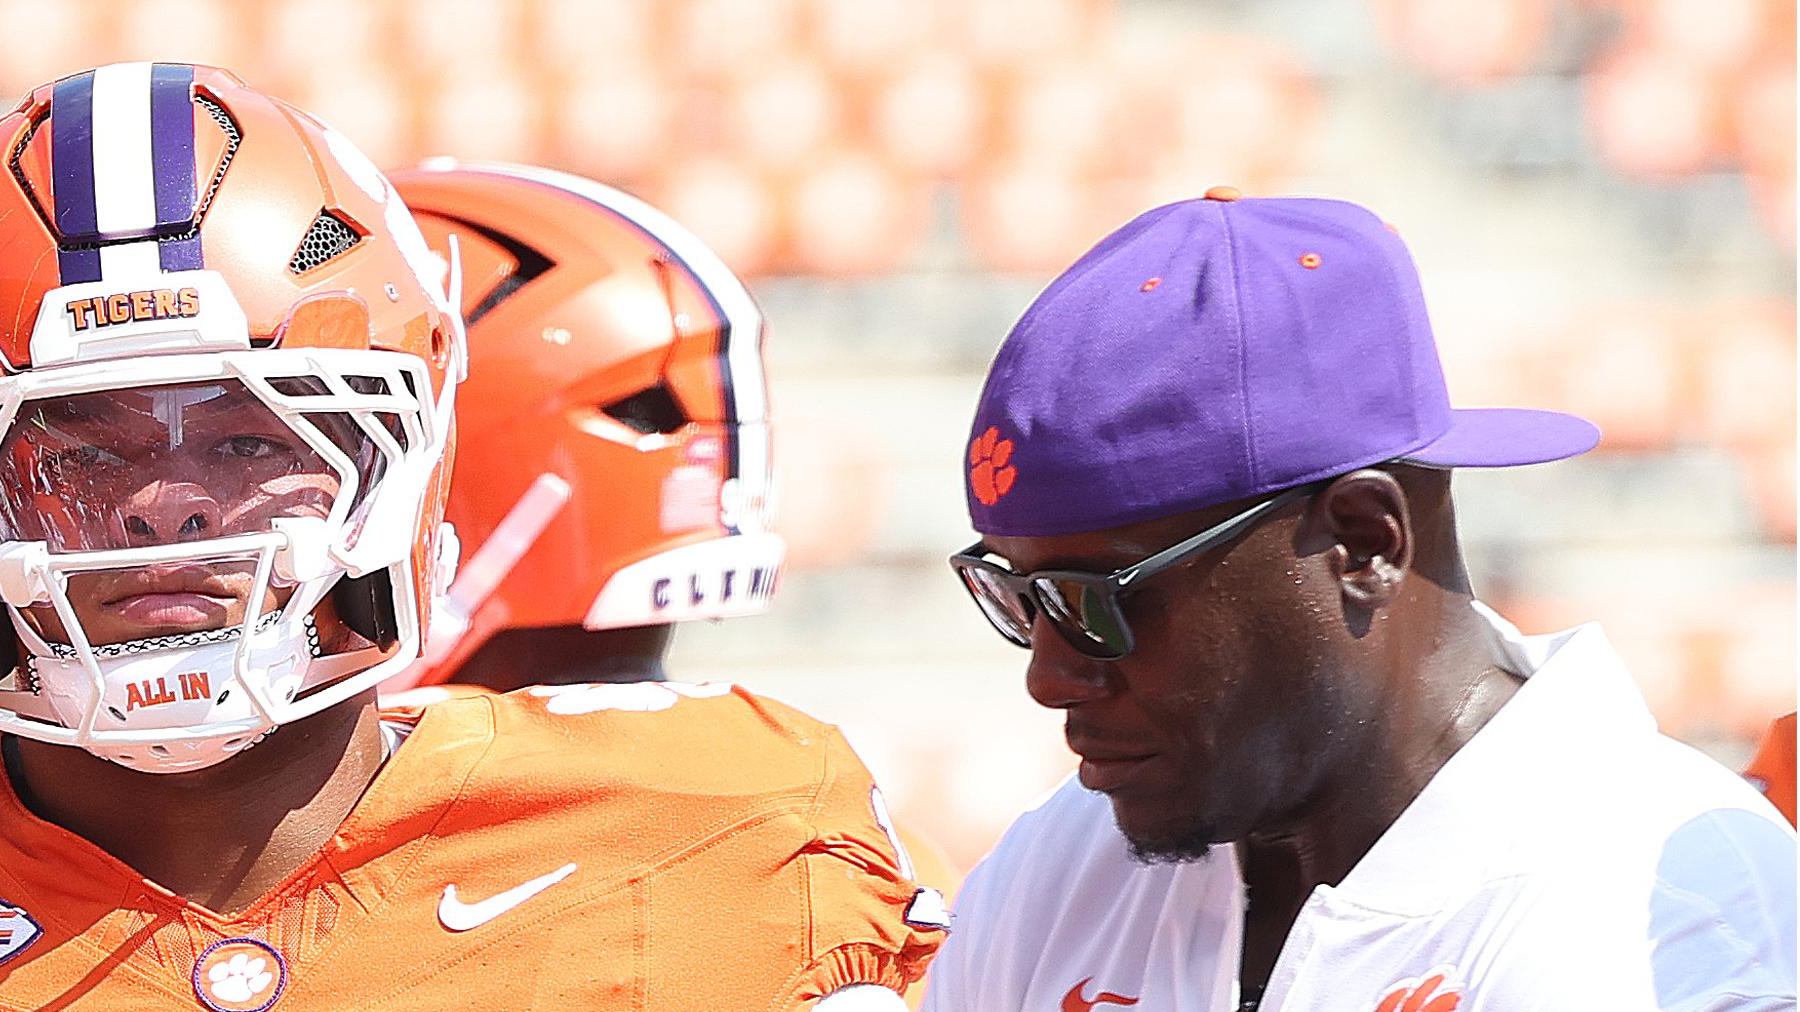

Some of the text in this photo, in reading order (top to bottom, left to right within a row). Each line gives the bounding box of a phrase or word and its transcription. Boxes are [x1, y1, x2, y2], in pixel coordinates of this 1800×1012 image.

[66, 287, 201, 332] TIGERS
[125, 671, 212, 713] ALL IN
